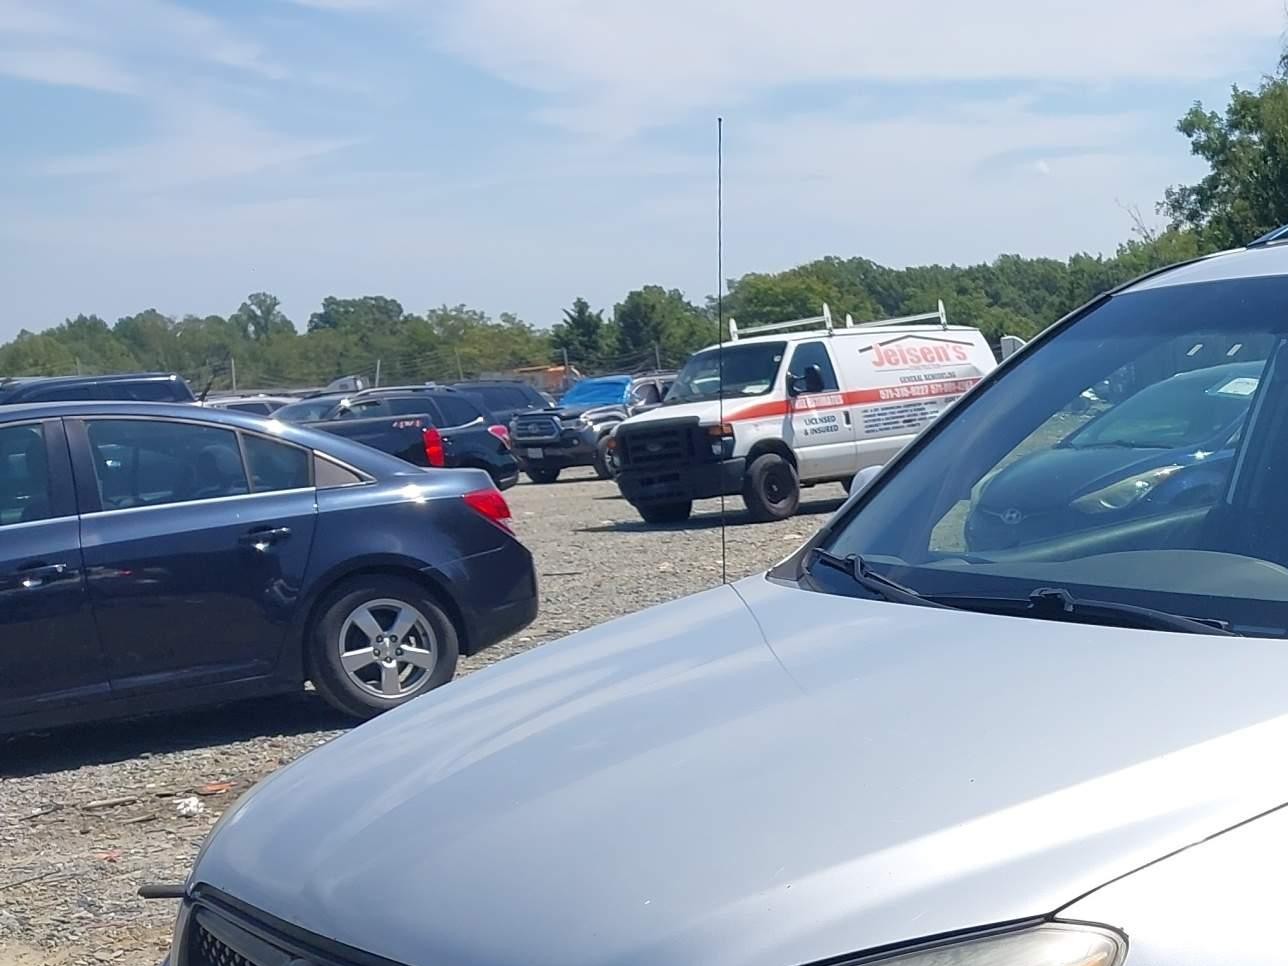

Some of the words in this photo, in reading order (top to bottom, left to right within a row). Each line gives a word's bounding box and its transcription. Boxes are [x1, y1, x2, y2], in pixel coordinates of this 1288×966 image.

[871, 343, 968, 368] Jeisen's
[804, 415, 837, 426] LICENSED
[810, 424, 839, 435] INSURED
